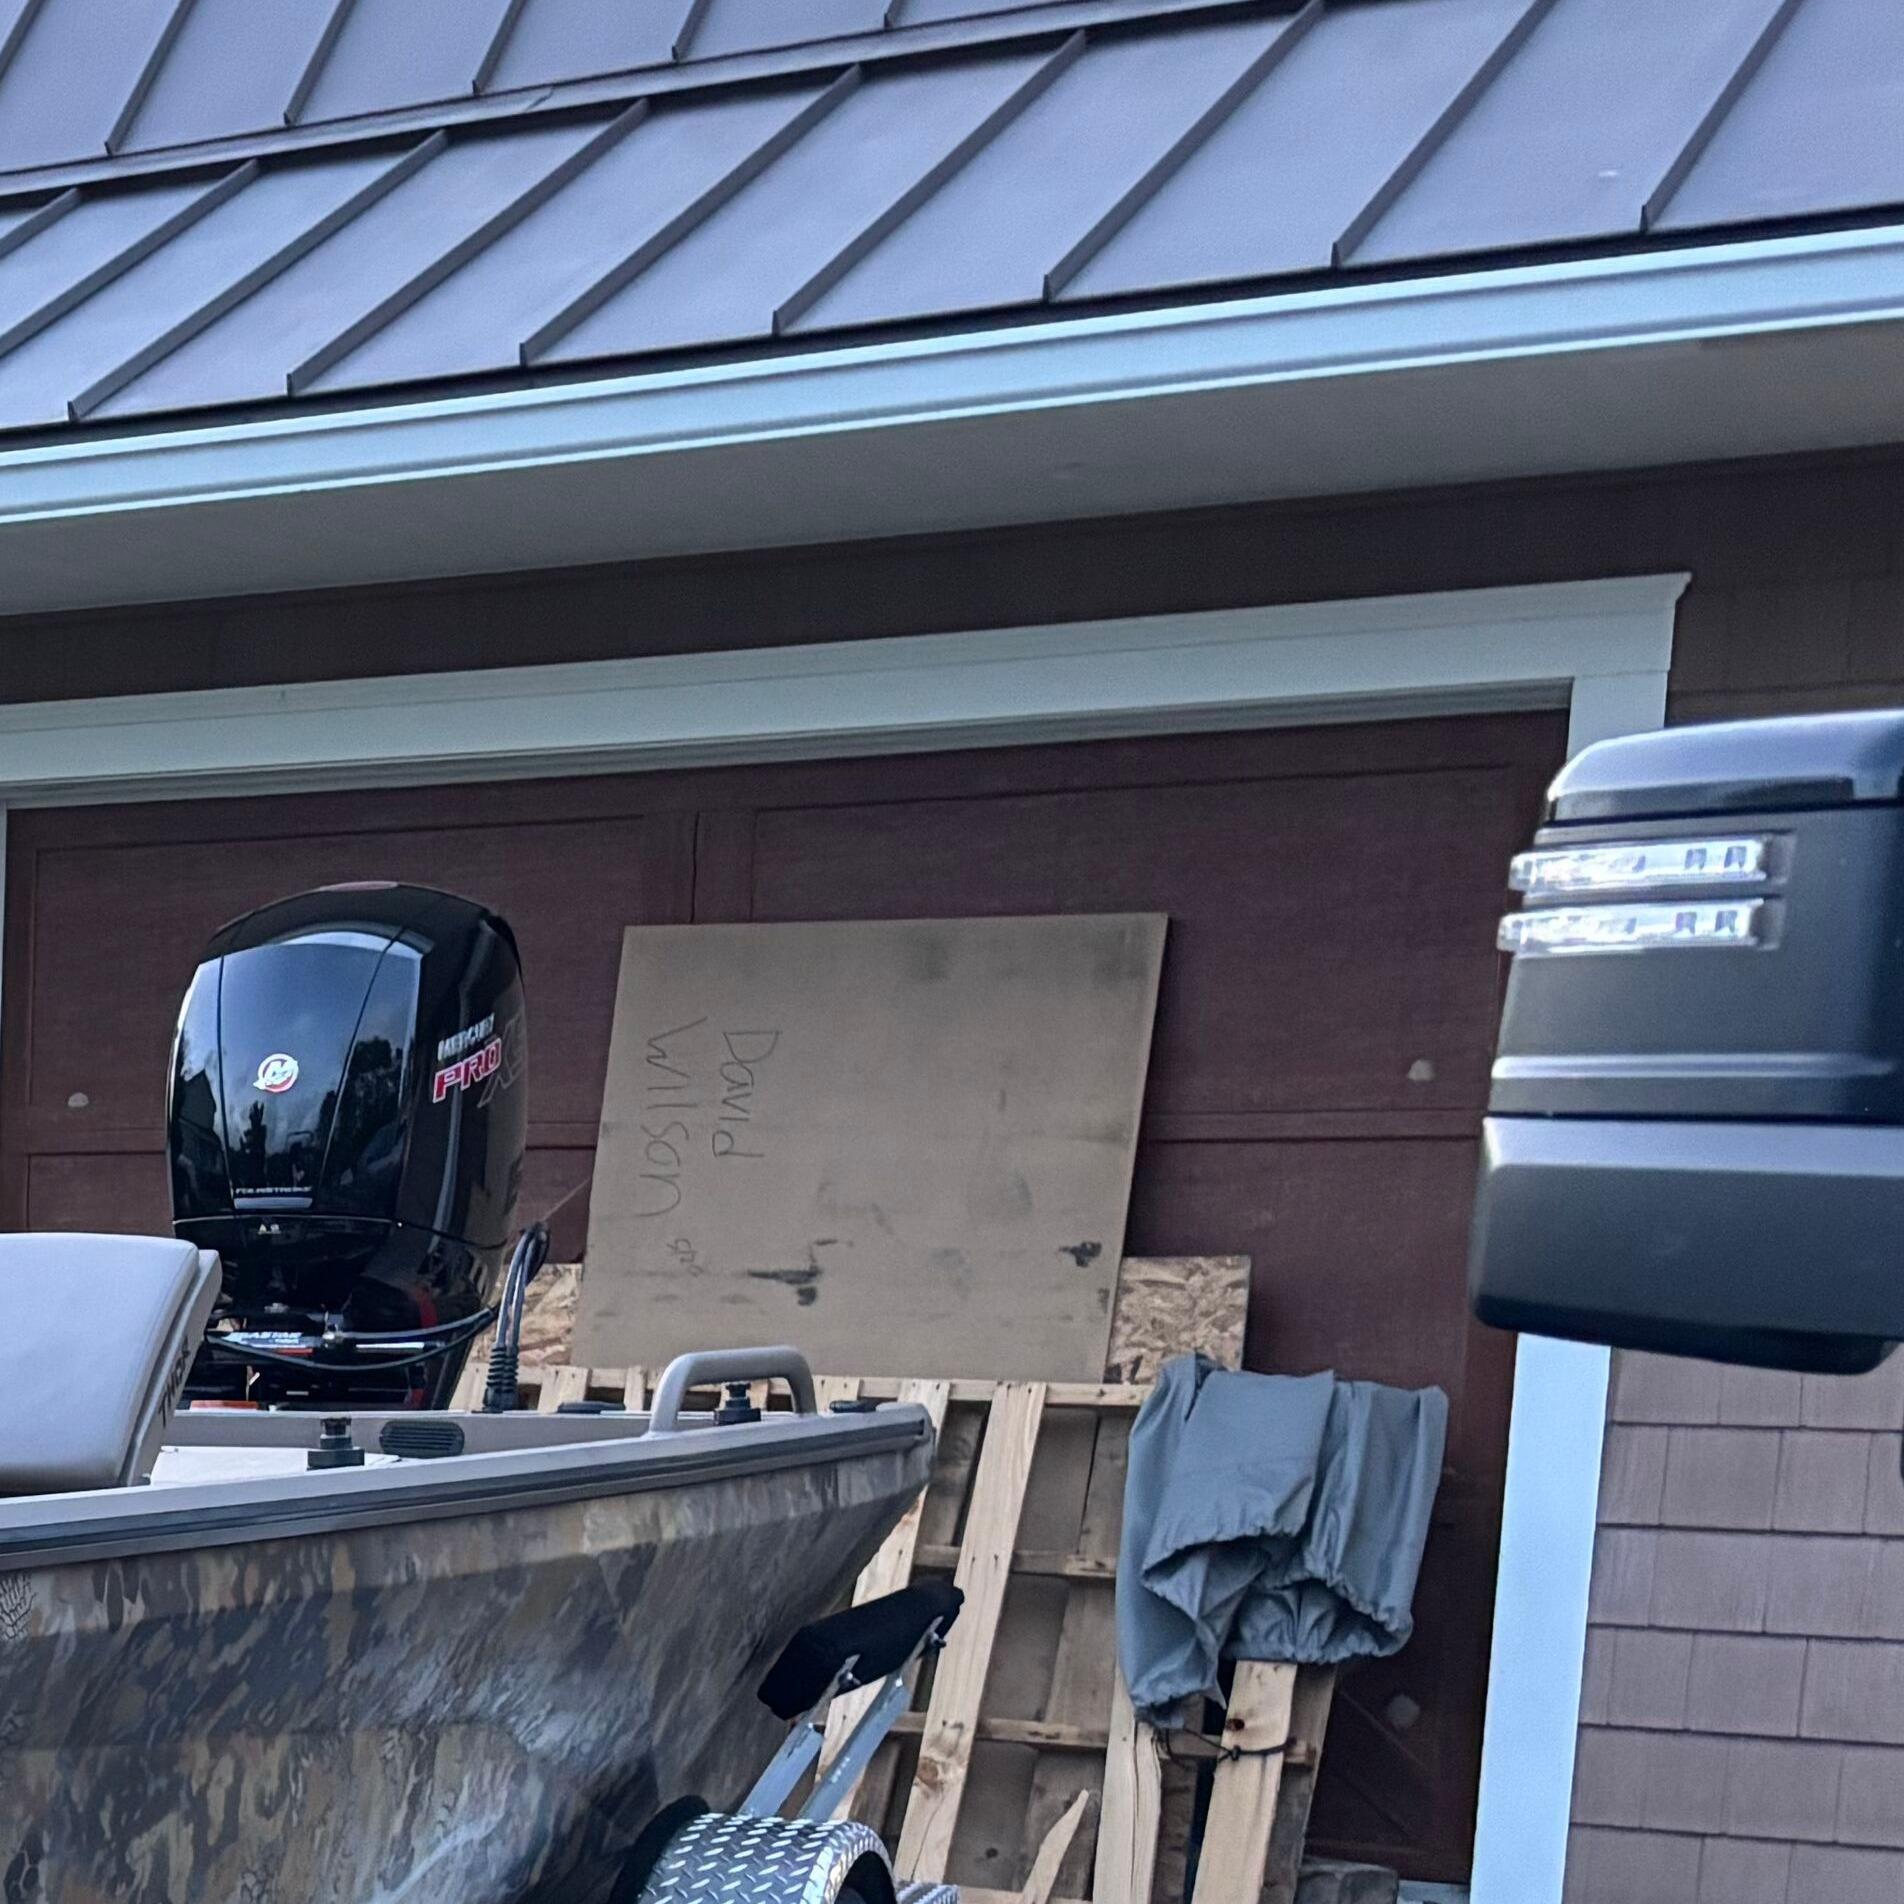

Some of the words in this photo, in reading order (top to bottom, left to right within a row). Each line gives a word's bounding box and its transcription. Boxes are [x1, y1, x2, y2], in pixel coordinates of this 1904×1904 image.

[432, 1037, 503, 1104] PRO
[635, 1016, 708, 1218] Wilson
[711, 1030, 782, 1157] David
